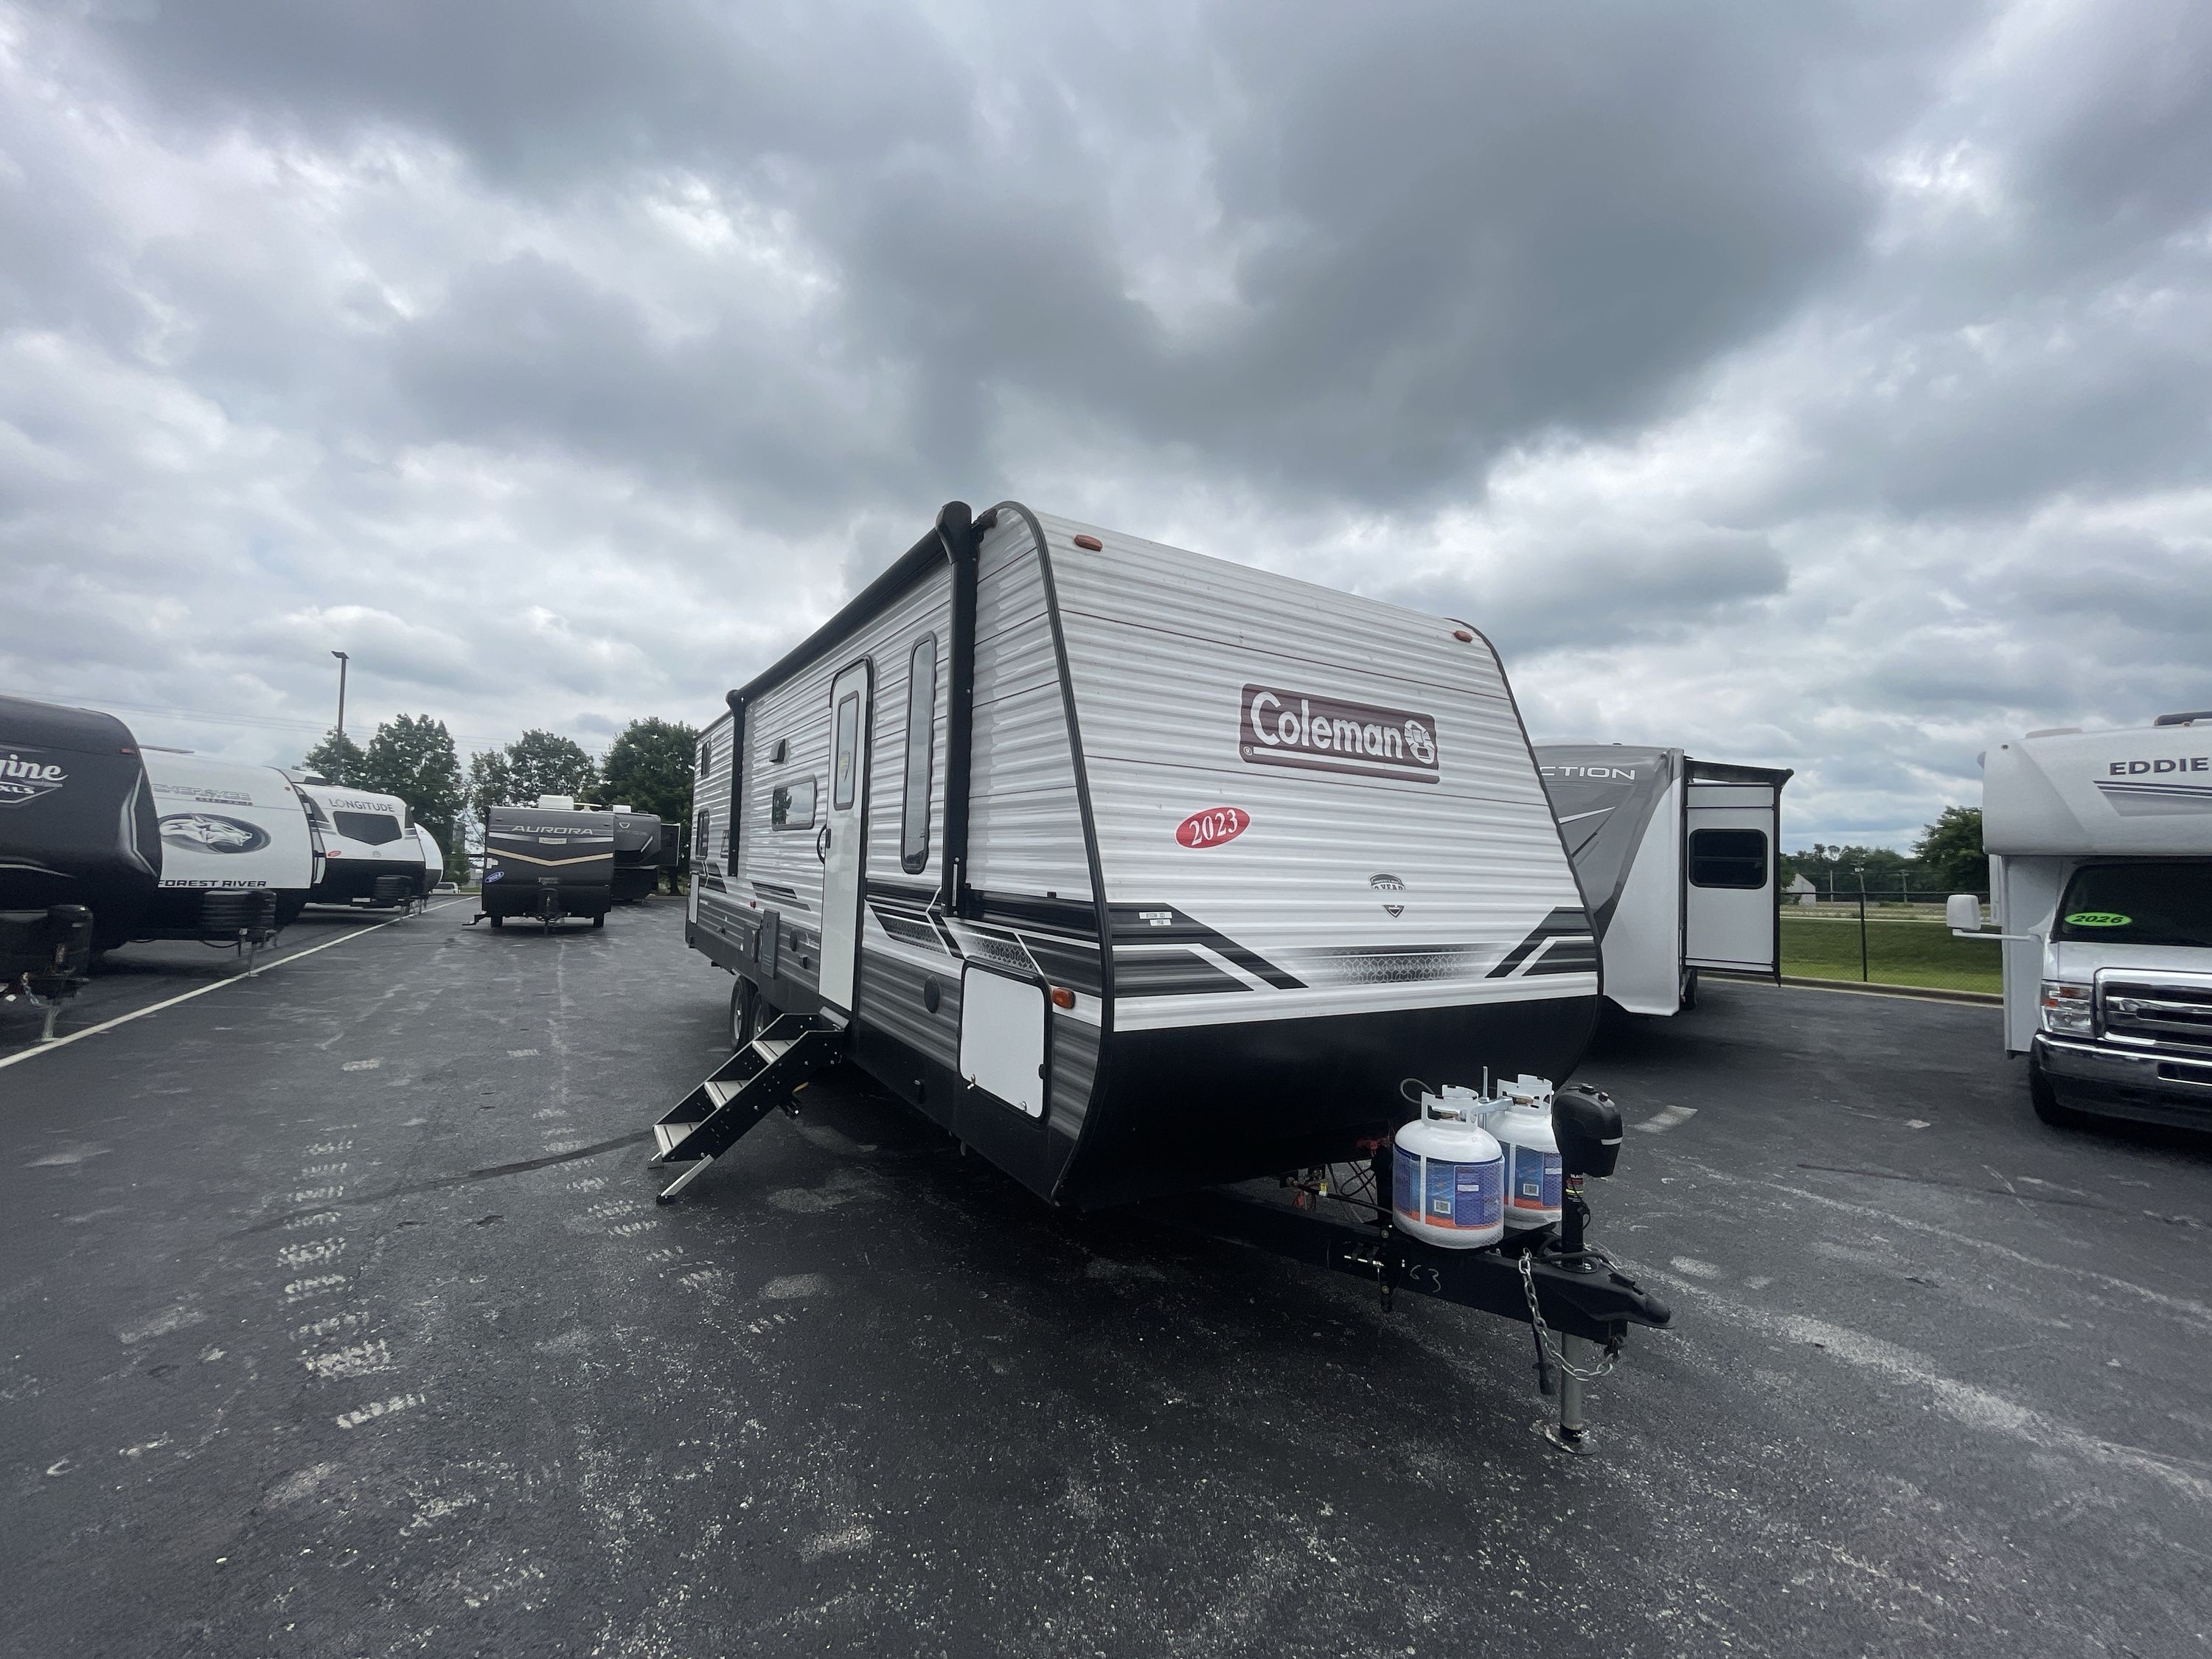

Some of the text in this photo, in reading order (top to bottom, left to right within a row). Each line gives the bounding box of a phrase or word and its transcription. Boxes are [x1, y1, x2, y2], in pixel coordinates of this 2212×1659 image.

[1251, 692, 1403, 759] Coleman
[0, 754, 69, 781] ine
[2110, 757, 2209, 775] EDDIE
[329, 799, 395, 812] LONGITUDE
[512, 826, 593, 835] AURORA
[1189, 809, 1238, 846] 2023
[2072, 915, 2124, 924] 2026
